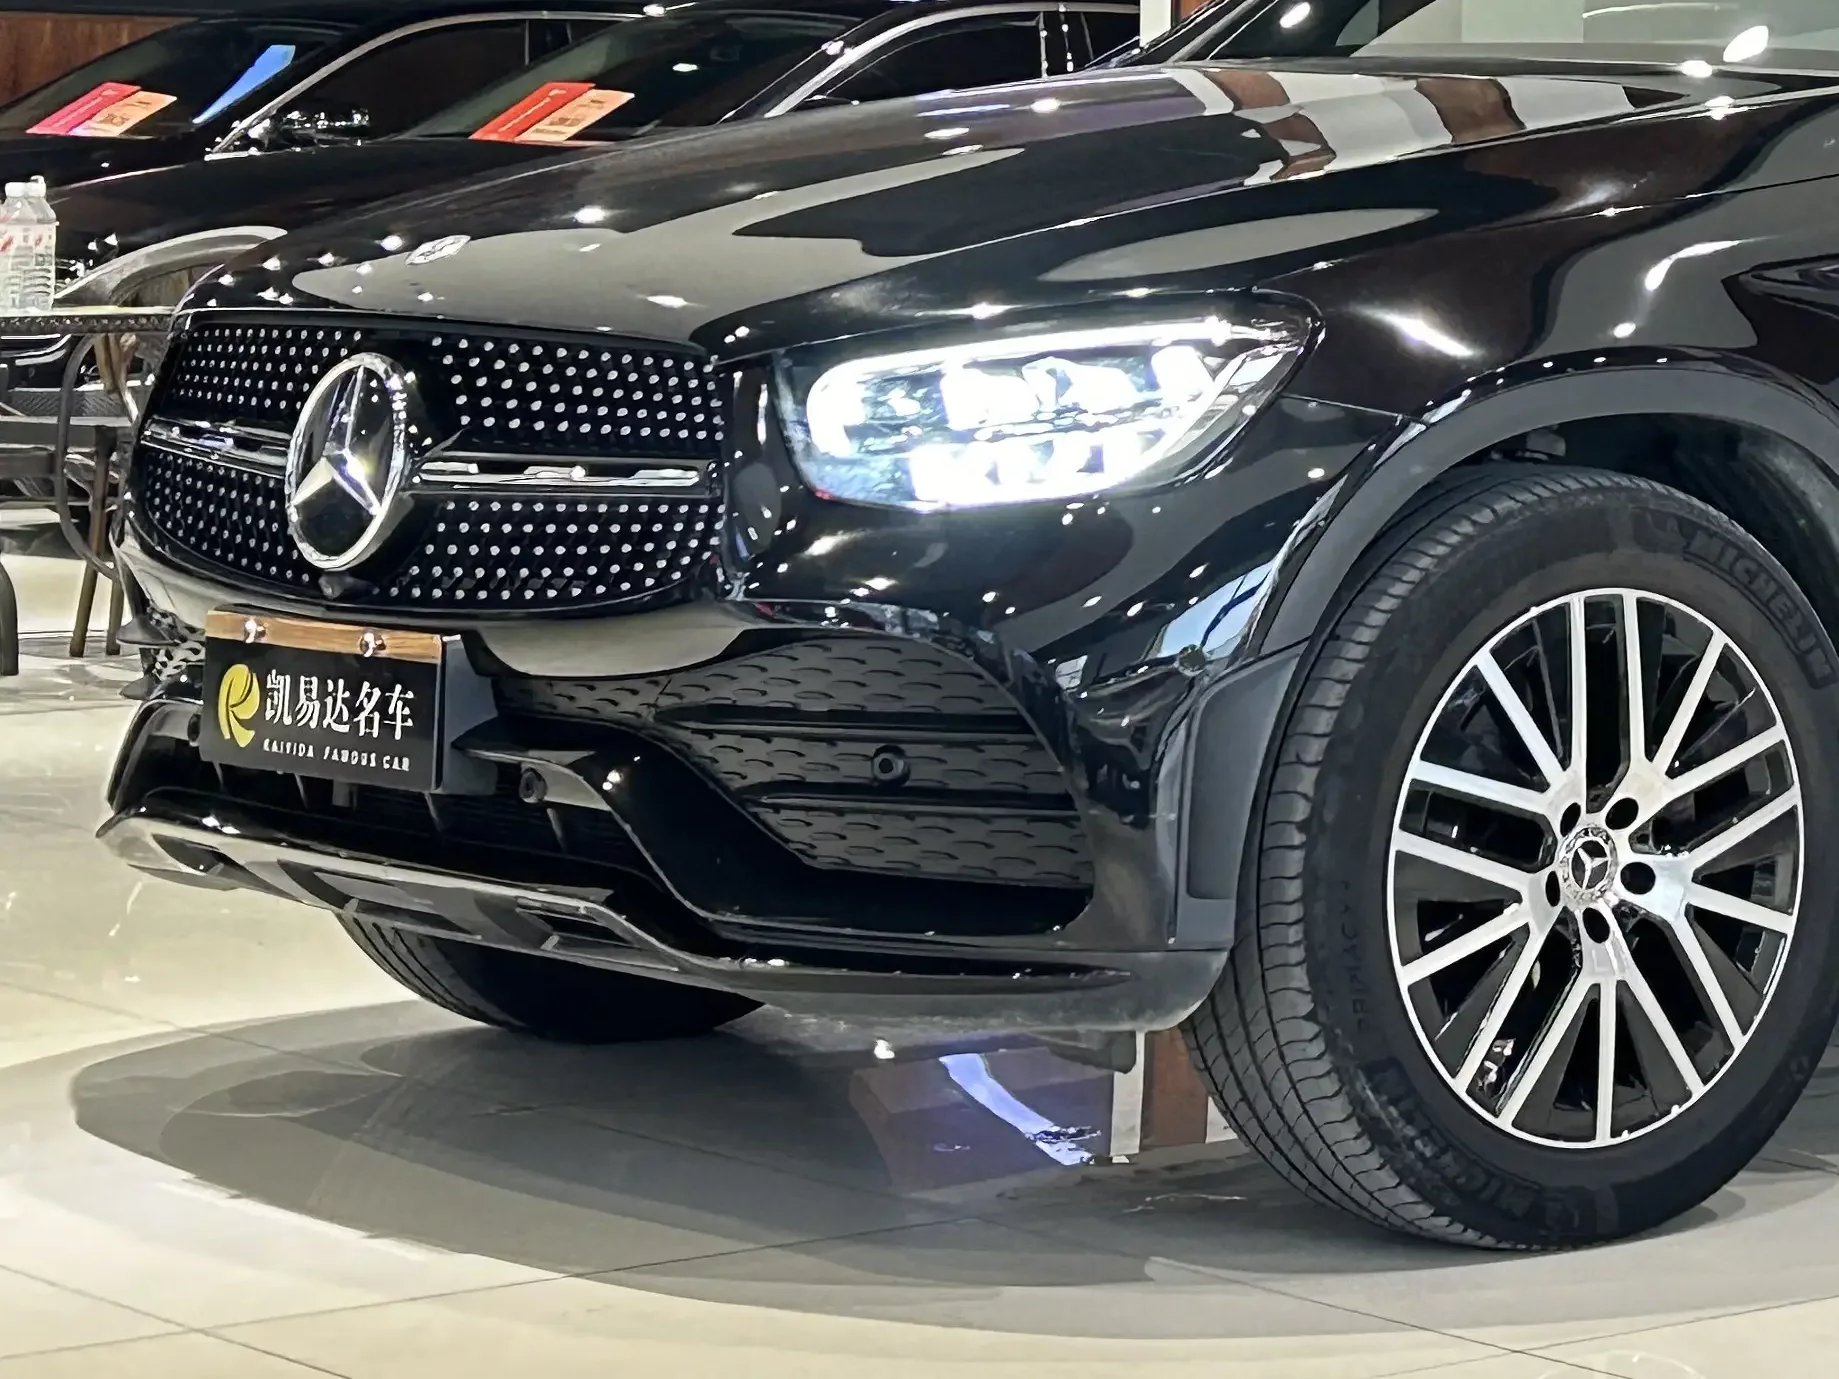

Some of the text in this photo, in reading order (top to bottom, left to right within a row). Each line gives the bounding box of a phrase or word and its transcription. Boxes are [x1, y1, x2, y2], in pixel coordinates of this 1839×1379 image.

[264, 668, 416, 741] 凯易达名车
[382, 755, 410, 772] CAR
